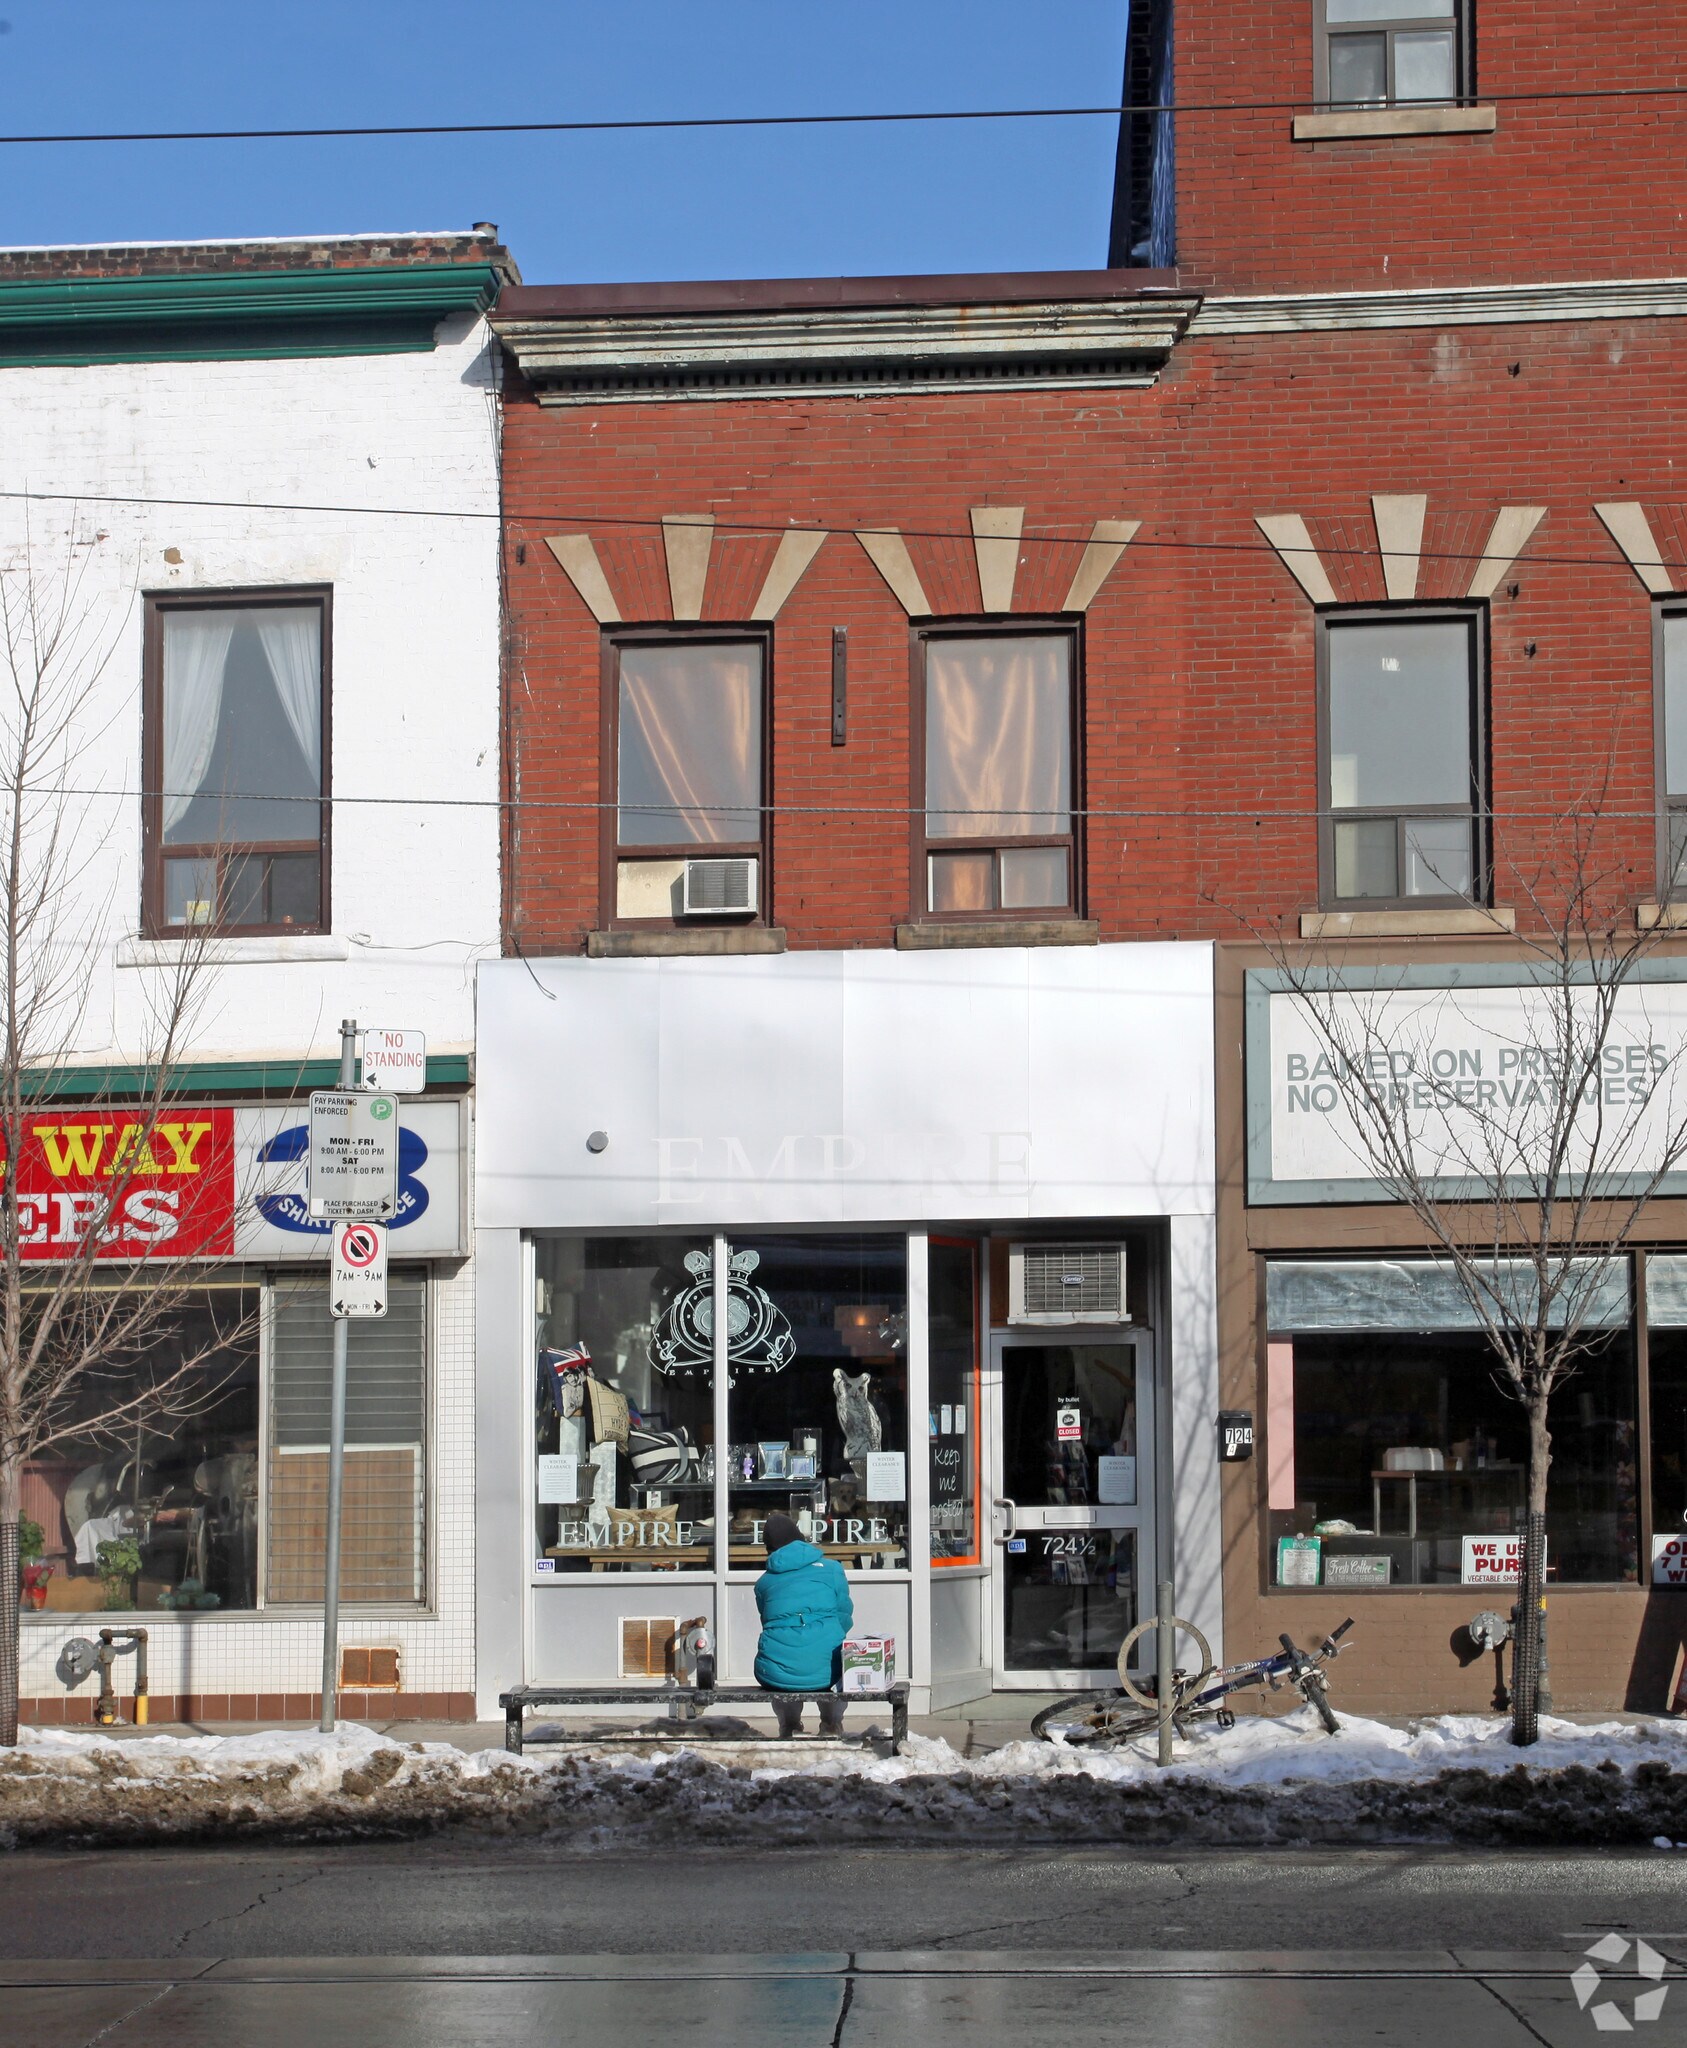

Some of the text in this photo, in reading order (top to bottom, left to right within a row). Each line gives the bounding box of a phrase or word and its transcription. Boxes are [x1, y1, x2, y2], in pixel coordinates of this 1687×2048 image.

[385, 1033, 404, 1048] NO
[366, 1051, 423, 1068] STANDING
[1287, 1050, 1415, 1081] BAKED
[1431, 1048, 1481, 1079] ON
[314, 1097, 358, 1106] PAY PARKING
[1287, 1076, 1649, 1113] NO PRESERVATIVES
[314, 1107, 349, 1116] ENFORCED
[329, 1137, 351, 1145] MON
[358, 1138, 374, 1146] FRI
[33, 1123, 212, 1177] WAY
[342, 1157, 359, 1165] SAT
[650, 1130, 1037, 1204] EMPRE
[321, 1166, 335, 1174] 8:00
[353, 1167, 370, 1175] 6:00
[371, 1167, 384, 1175] PM
[669, 1366, 772, 1376] EMPIRE
[1058, 1428, 1080, 1436] CLOSED
[1226, 1428, 1252, 1443] 724
[934, 1448, 961, 1474] Keep
[939, 1475, 956, 1491] me
[931, 1495, 964, 1519] posted
[557, 1520, 696, 1548] EMPIRE
[750, 1518, 889, 1545] EPIRE
[1471, 1544, 1497, 1556] WE
[1327, 1560, 1349, 1575] Fresh
[1350, 1559, 1372, 1575] Coffee
[1475, 1558, 1520, 1573] PUR
[1661, 1557, 1672, 1569] 7
[1467, 1574, 1501, 1583] VEGETABLE
